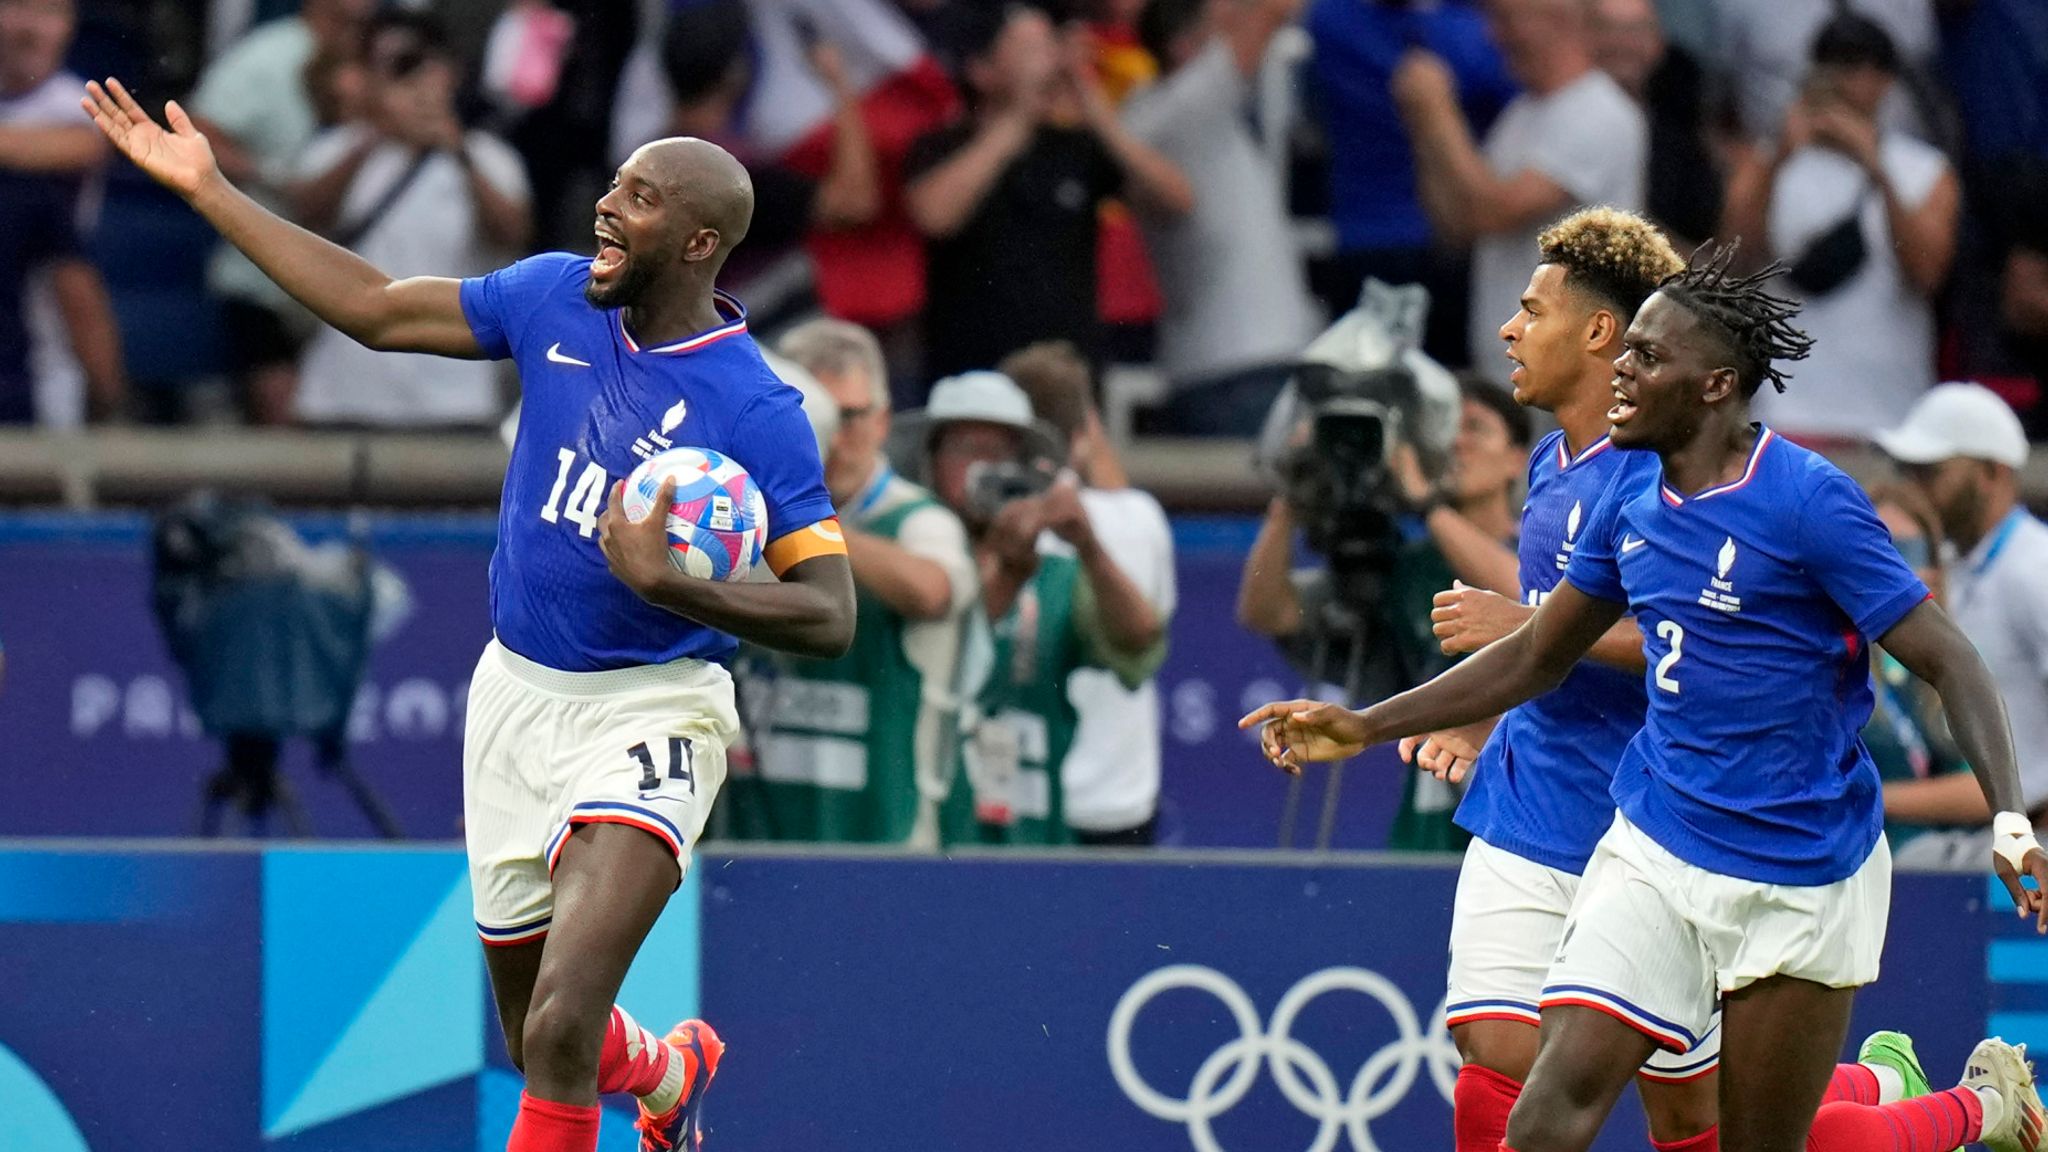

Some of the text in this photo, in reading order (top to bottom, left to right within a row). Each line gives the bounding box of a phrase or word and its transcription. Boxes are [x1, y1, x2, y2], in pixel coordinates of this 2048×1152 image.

[648, 429, 673, 450] FRANCE
[540, 447, 607, 538] 14
[1711, 577, 1732, 592] FRANCE
[1656, 620, 1683, 694] 2
[627, 737, 695, 796] 14
